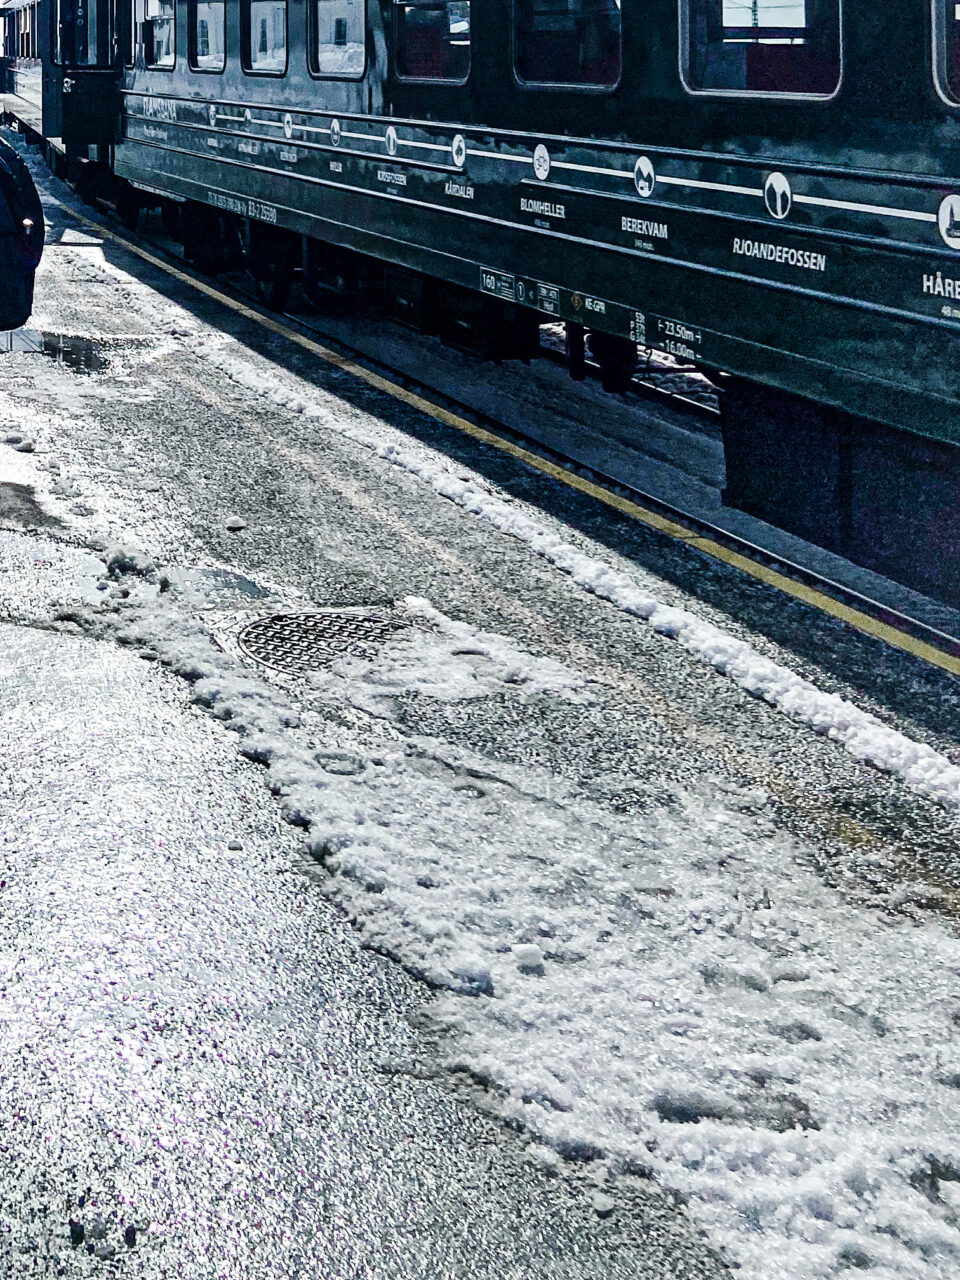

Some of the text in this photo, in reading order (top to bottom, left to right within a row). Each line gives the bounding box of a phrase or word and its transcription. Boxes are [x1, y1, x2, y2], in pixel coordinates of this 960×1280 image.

[444, 180, 474, 199] KÅRDALEN
[520, 197, 566, 219] BLOMHELLER
[621, 216, 668, 239] BEREKVAM
[732, 237, 826, 271] RJOANDEFOSSEN
[482, 273, 496, 290] 160
[665, 321, 695, 341] 23.50m
[665, 339, 696, 360] 16.00m
